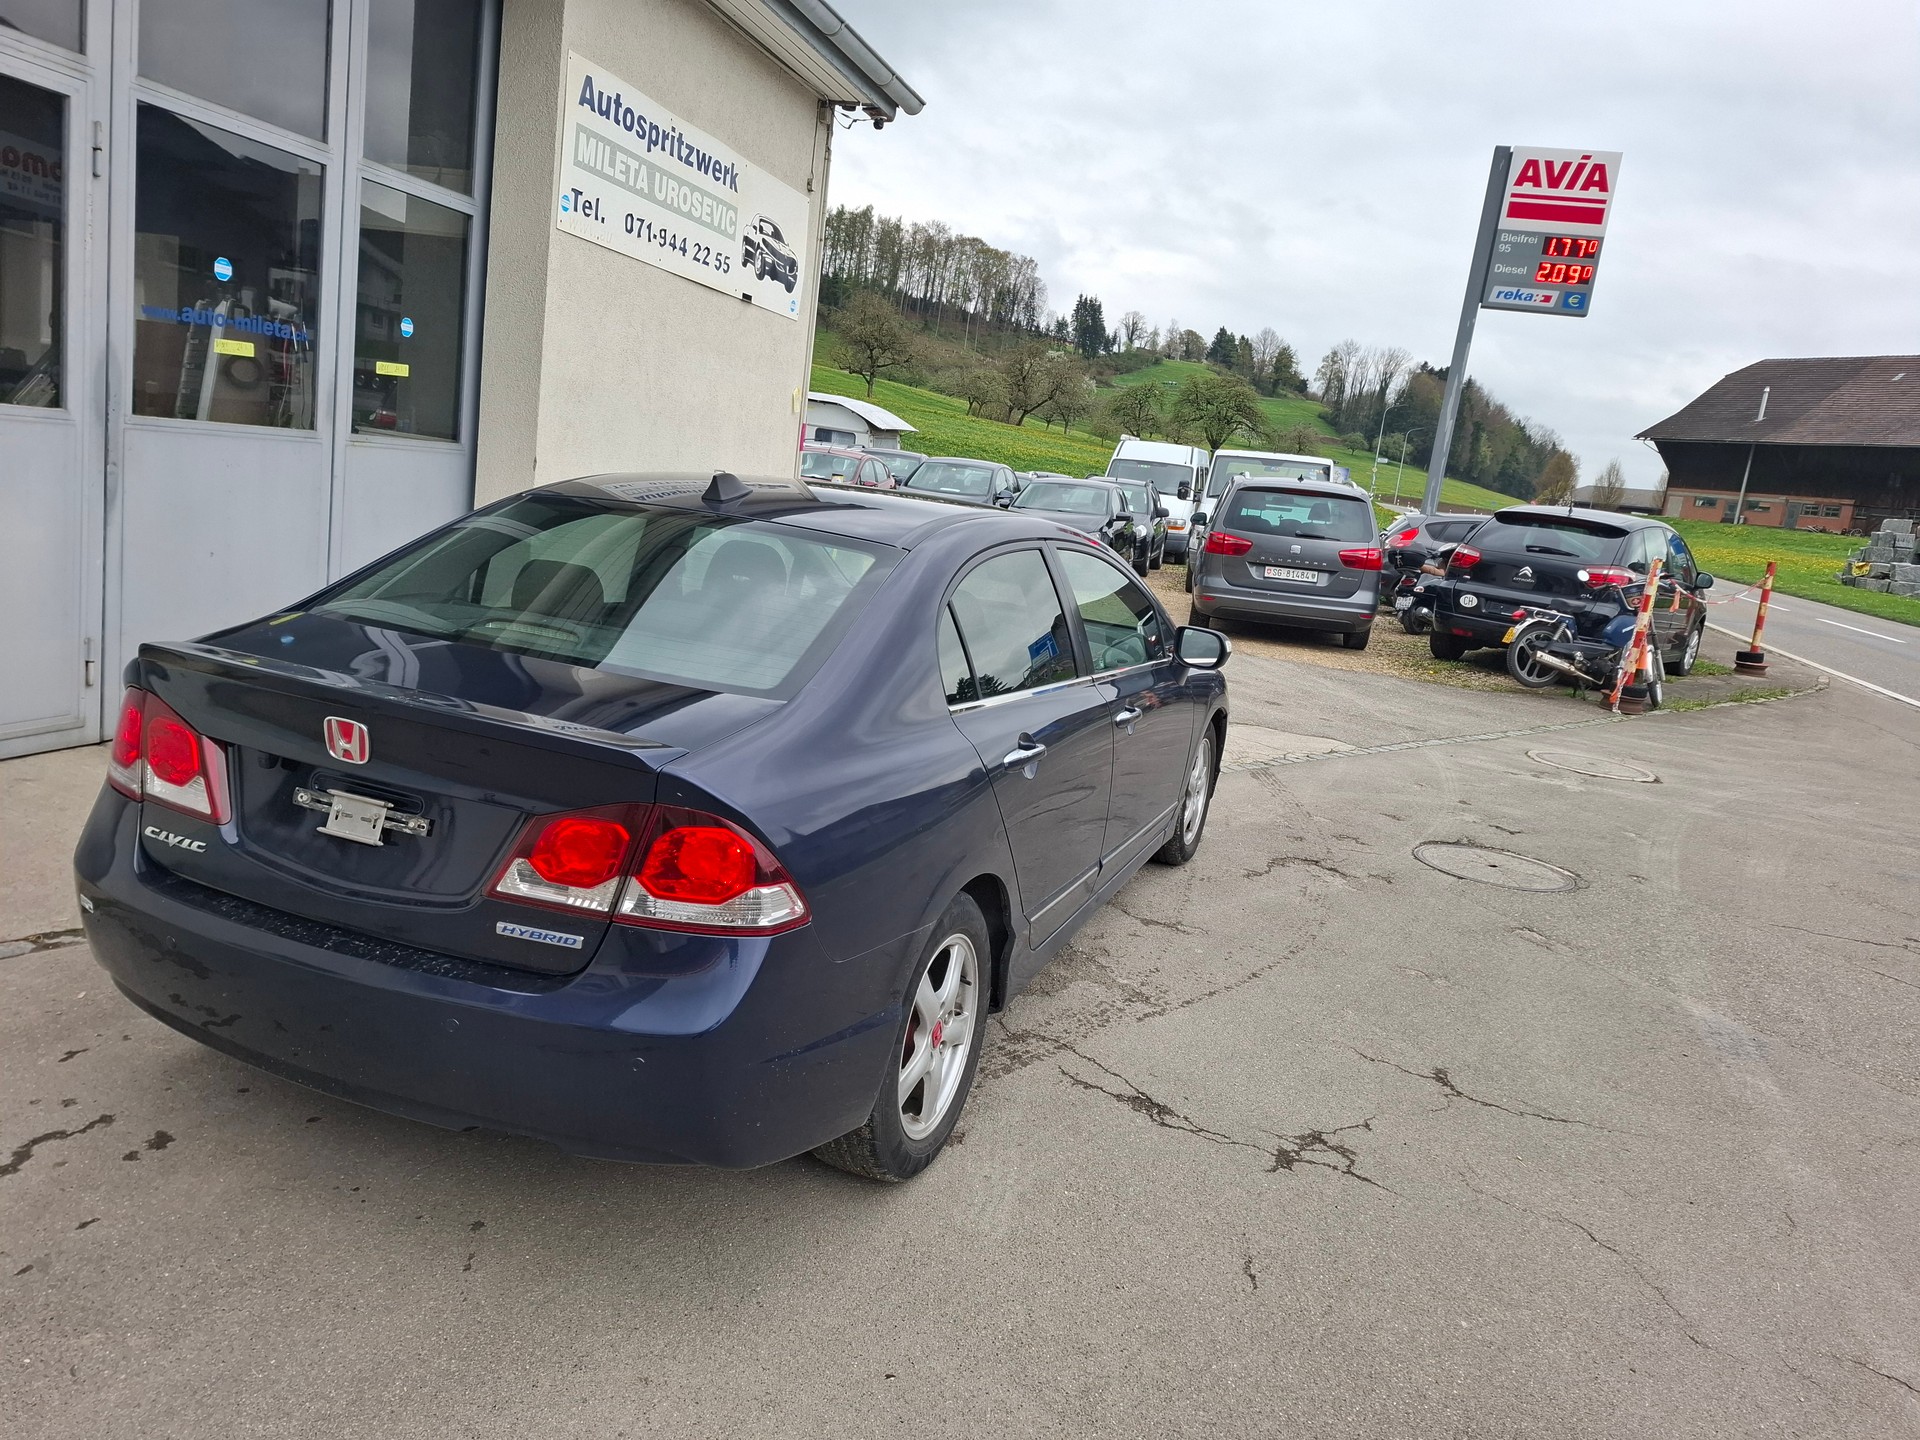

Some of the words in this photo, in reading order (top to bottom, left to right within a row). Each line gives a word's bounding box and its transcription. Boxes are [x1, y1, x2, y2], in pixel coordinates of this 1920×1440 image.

[578, 74, 739, 194] Autospritzwerk
[577, 131, 649, 194] MILETA
[654, 172, 737, 235] UROSEVIC
[570, 187, 606, 225] Tel.
[692, 242, 711, 267] 22
[714, 252, 731, 274] 55
[1500, 232, 1539, 245] Bleifrei
[1498, 243, 1512, 253] 95
[1494, 263, 1528, 275] Diesel
[1463, 596, 1474, 606] CH
[144, 826, 207, 853] CIVIC
[501, 925, 577, 946] HYBRID
